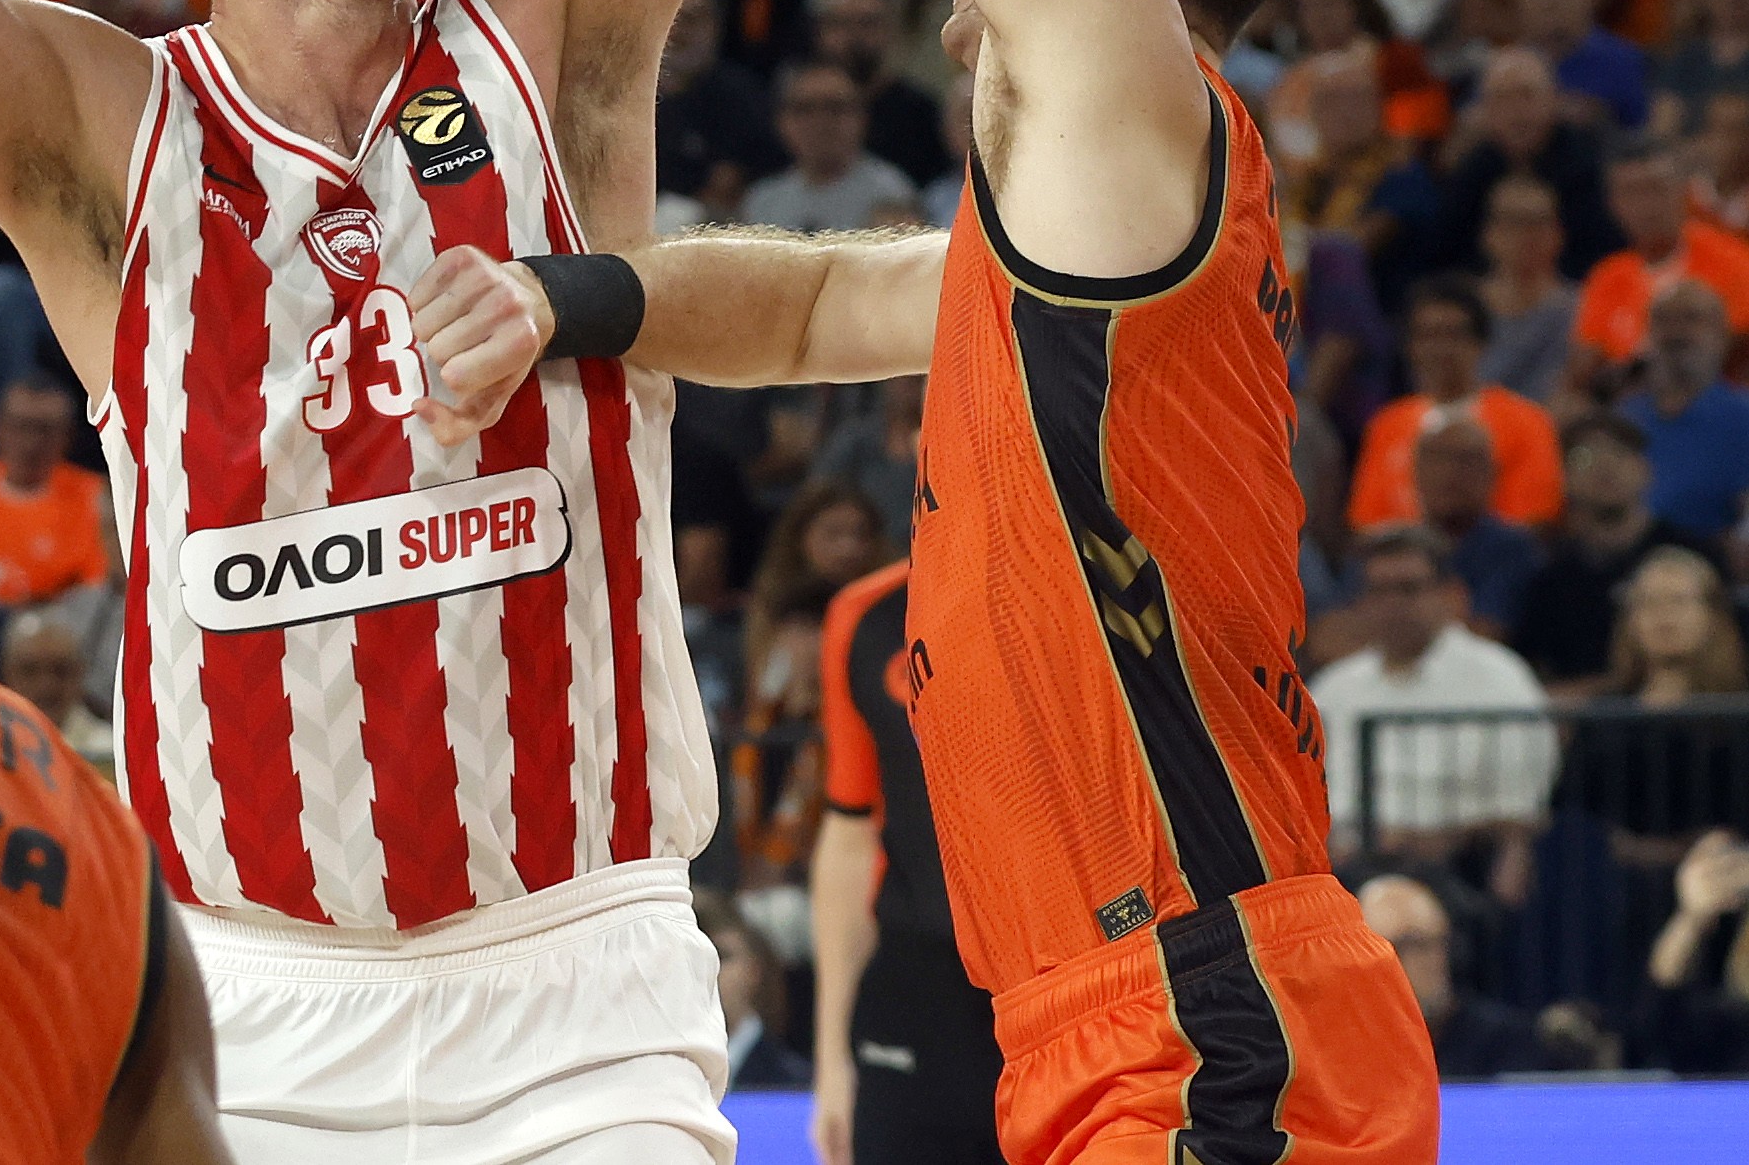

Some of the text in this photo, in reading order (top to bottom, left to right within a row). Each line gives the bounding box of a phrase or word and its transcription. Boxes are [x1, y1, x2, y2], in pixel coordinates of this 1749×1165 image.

[422, 148, 487, 179] ETIHAD
[302, 284, 429, 434] 33
[398, 496, 537, 570] SUPER
